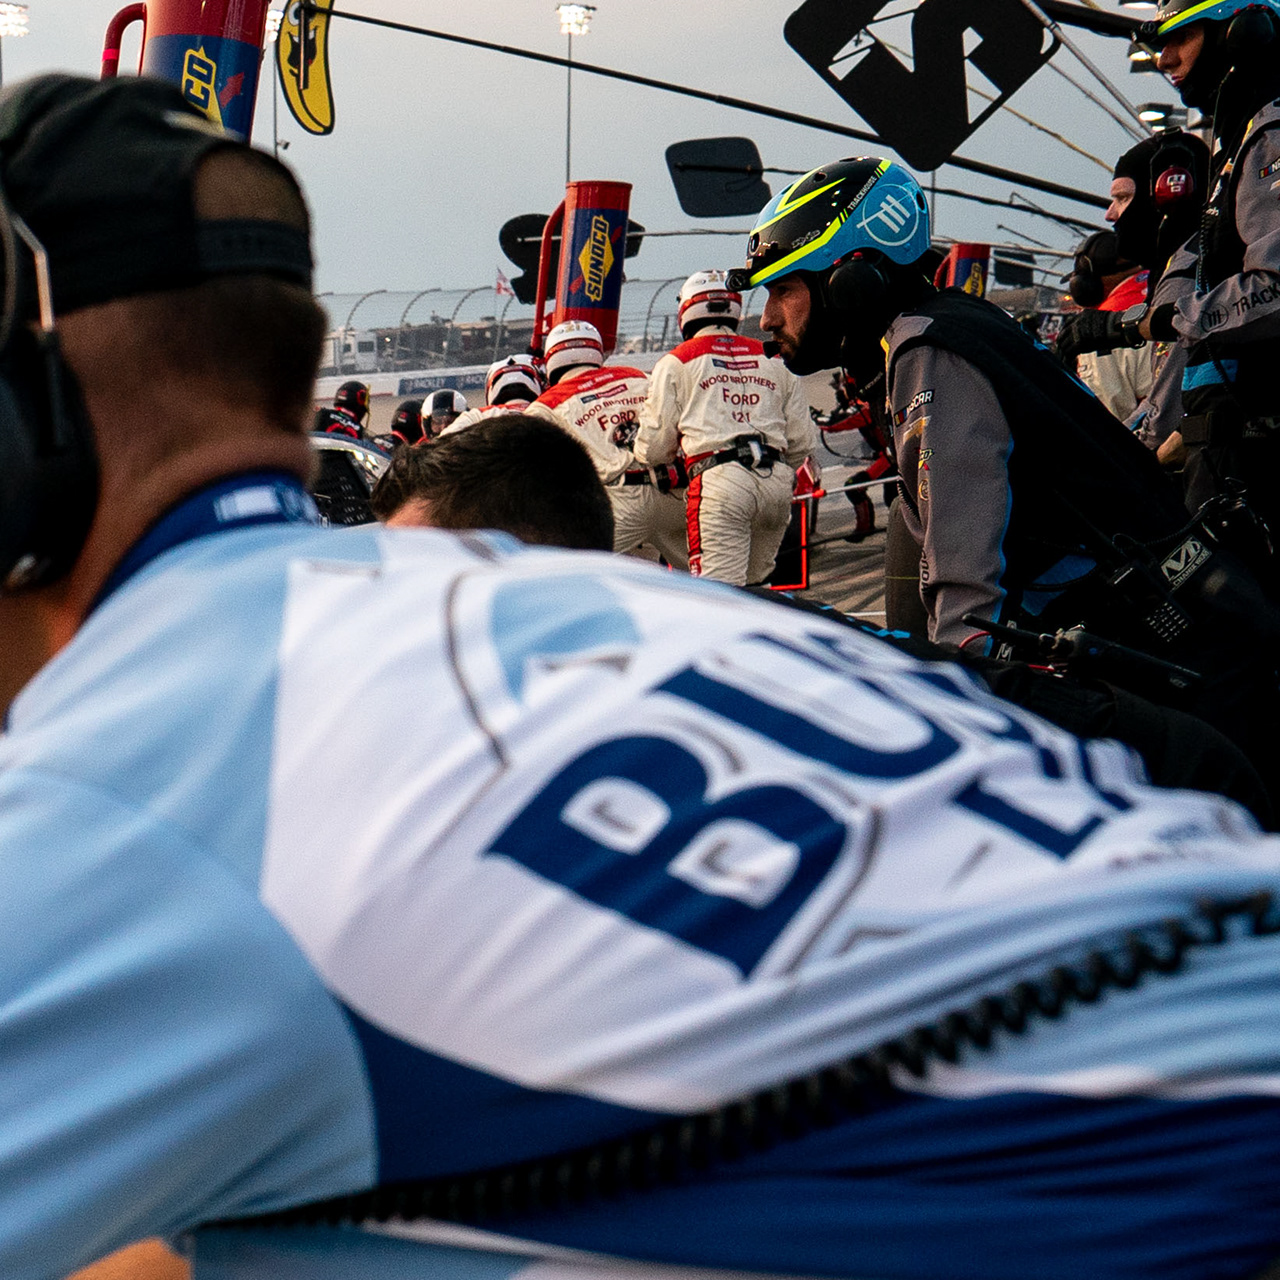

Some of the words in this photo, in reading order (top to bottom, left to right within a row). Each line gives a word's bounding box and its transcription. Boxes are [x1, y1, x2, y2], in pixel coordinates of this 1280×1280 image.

[587, 217, 608, 301] SUNOCO
[699, 374, 729, 391] WOOD
[729, 374, 777, 391] BROTHERS
[722, 387, 760, 406] FORD
[575, 404, 602, 427] WOOD
[597, 409, 637, 432] FORD
